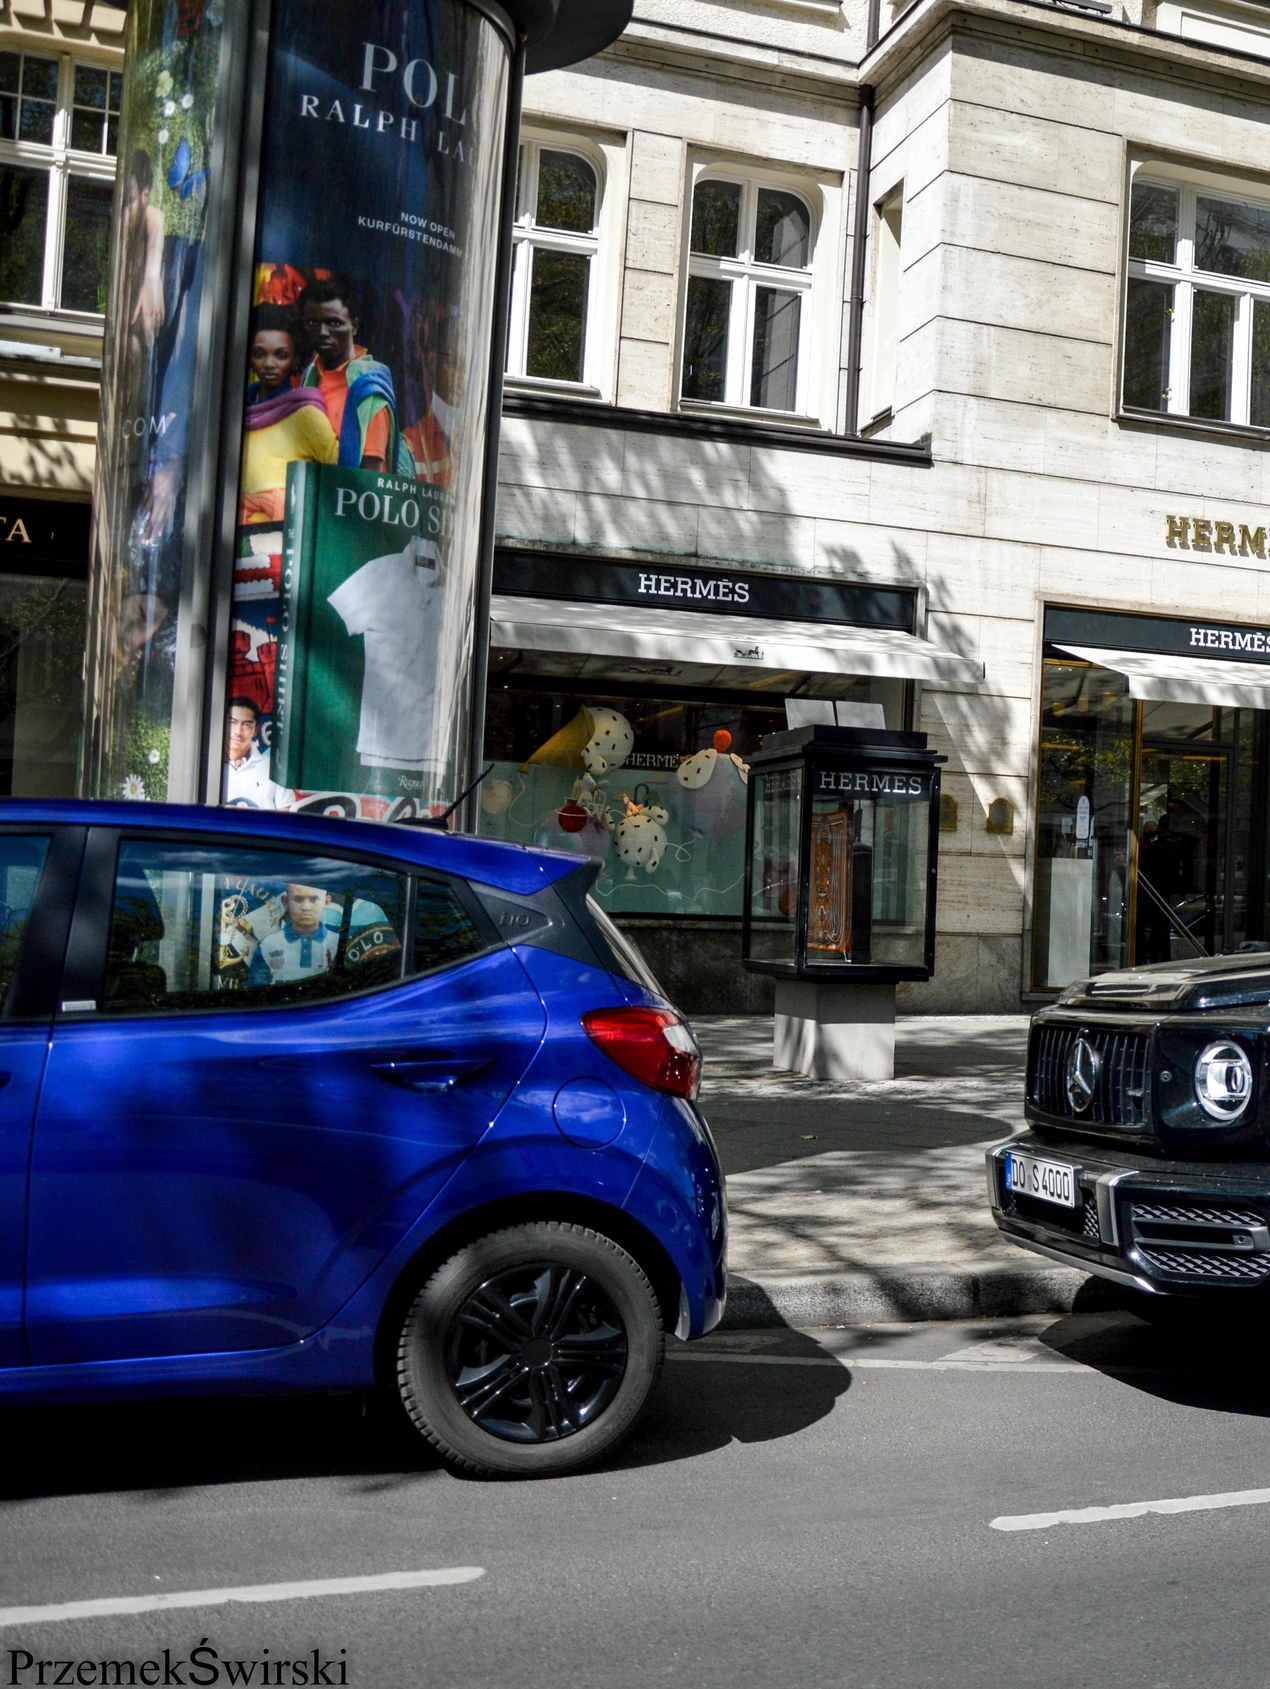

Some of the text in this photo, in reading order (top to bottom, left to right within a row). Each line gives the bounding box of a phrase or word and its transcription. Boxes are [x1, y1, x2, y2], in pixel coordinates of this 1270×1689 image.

[299, 94, 418, 142] RALPH
[357, 215, 463, 259] KURFÜRSTENDAMM
[400, 211, 456, 240] NOW OPEN
[377, 477, 417, 495] RALPH
[334, 487, 420, 528] POLO
[280, 548, 295, 633] POLO
[637, 573, 750, 603] HERMÈS
[276, 643, 289, 736] SHIRT
[499, 911, 530, 926] i10
[1011, 1158, 1070, 1201] DO S 4000
